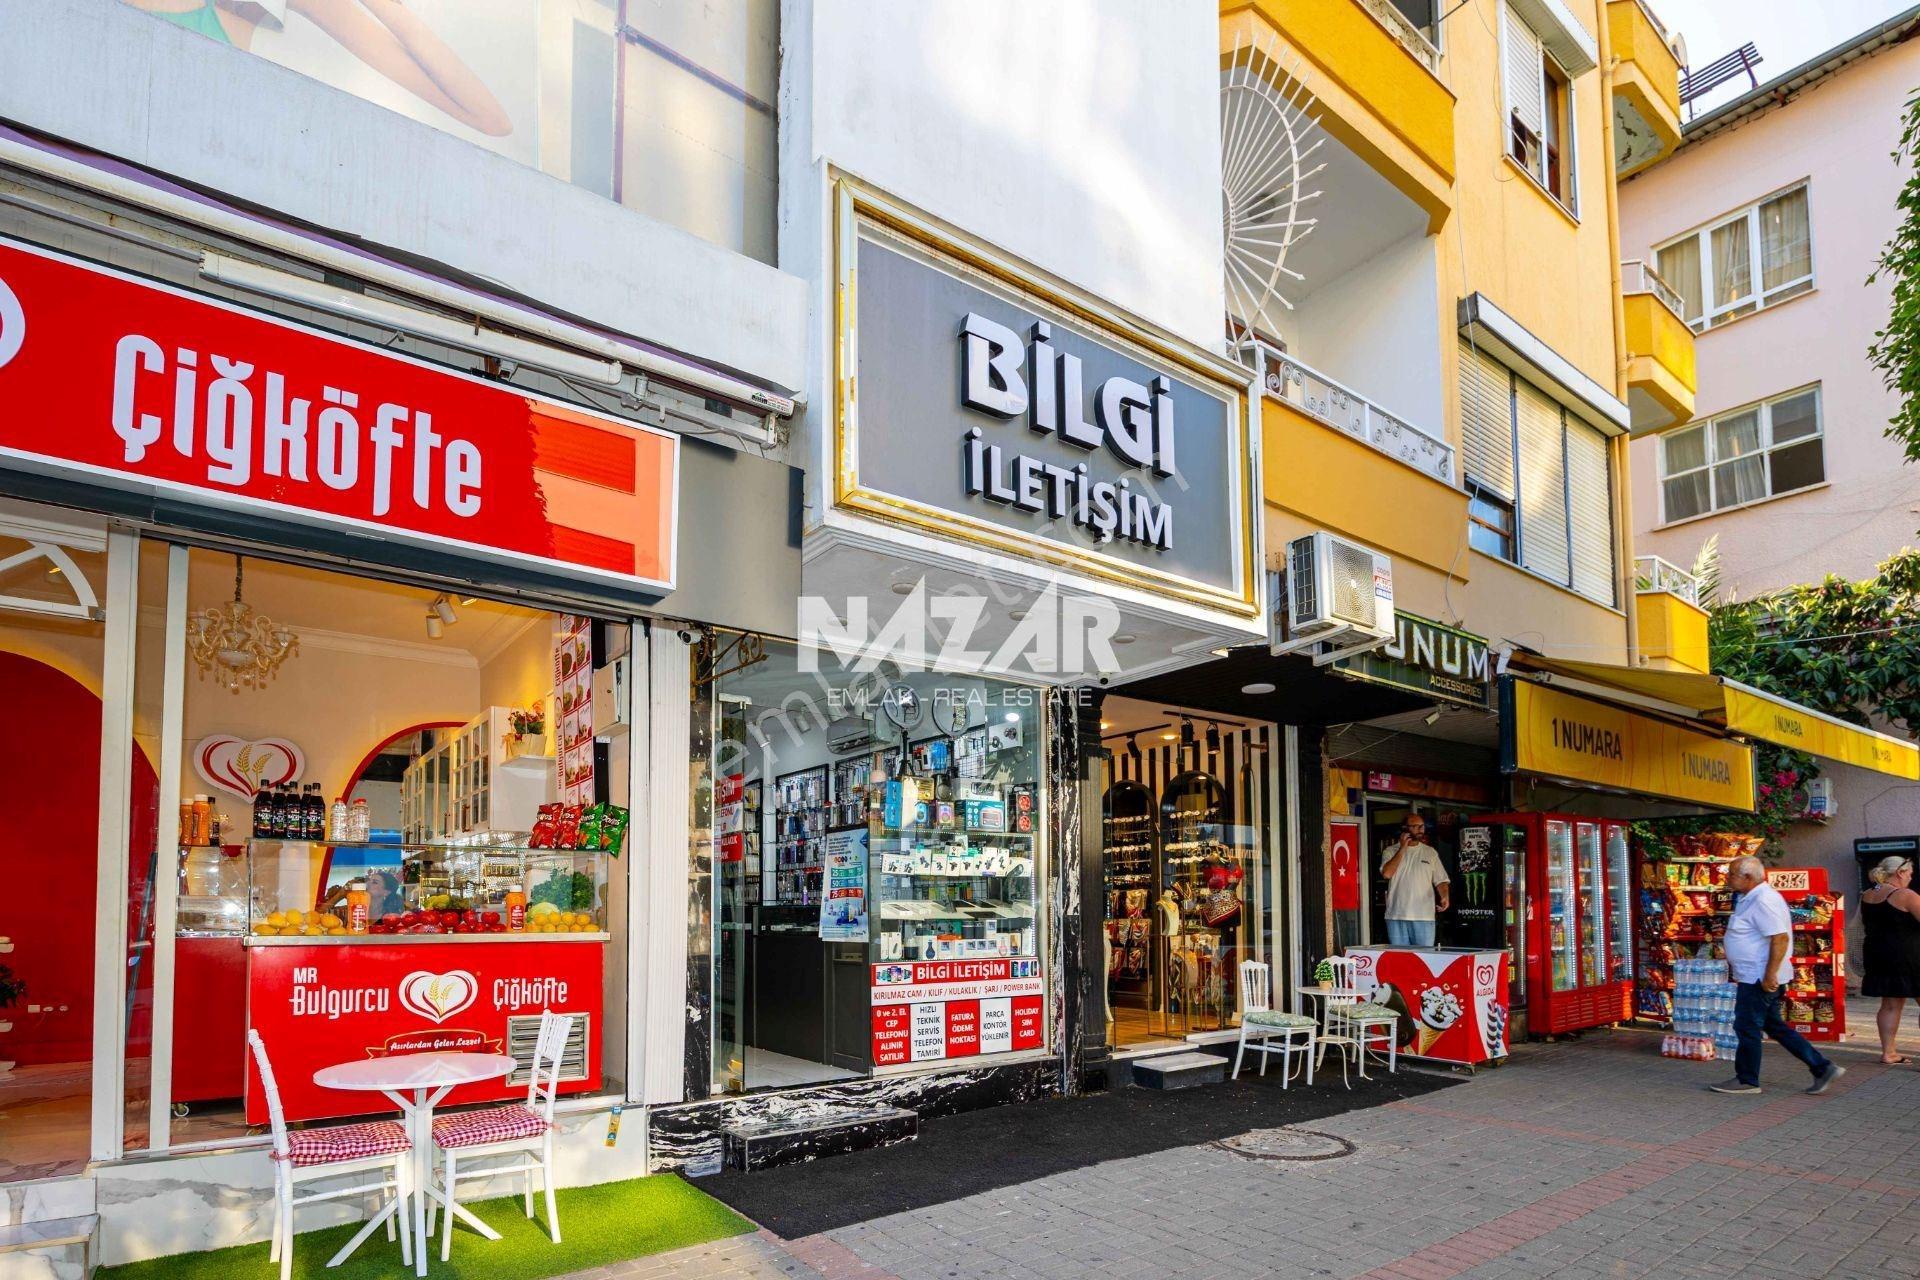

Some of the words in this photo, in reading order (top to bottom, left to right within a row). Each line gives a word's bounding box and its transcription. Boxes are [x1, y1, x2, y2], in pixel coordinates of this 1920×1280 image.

[958, 312, 1175, 479] BİLGİ
[112, 334, 482, 517] Çiğköfte
[964, 426, 1173, 552] İLETİŞİM
[1429, 674, 1482, 699] ACCESSORIES
[1552, 717, 1559, 748] 1
[1562, 719, 1623, 761] NUMARA
[1682, 752, 1686, 776] 1
[1688, 757, 1731, 786] NUMARA
[1457, 908, 1495, 917] MONSTER
[294, 967, 318, 984] MR
[917, 962, 950, 980] BİLGİ
[953, 960, 1005, 980] İLETİŞİM
[1349, 969, 1373, 978] AGIDA
[493, 976, 568, 1011] Çiğköfte
[874, 989, 906, 1000] KIRILMAZ
[907, 988, 922, 998] CAM
[928, 988, 943, 997] KILIF
[949, 986, 977, 996] KULAKLIK
[1003, 983, 1023, 993] POWER
[1024, 982, 1041, 992] BANK
[1476, 988, 1496, 997] ALGIDA
[289, 985, 389, 1020] Bulgurcu
[919, 1005, 937, 1014] HIZLI
[1014, 1007, 1039, 1017] HOLIDAY
[916, 1014, 941, 1025] TEKNİK
[951, 1013, 975, 1022] FATURA
[885, 1019, 898, 1028] CEP
[951, 1023, 974, 1033] ÖDEME
[875, 1029, 909, 1038] TELEFONU
[917, 1025, 940, 1036] SERVİS
[1019, 1029, 1035, 1038] CARD
[390, 1040, 432, 1052] Asırlardan
[434, 1038, 456, 1050] Gelen
[456, 1037, 481, 1047] Lezzet
[880, 1041, 903, 1051] ALINIR
[914, 1038, 943, 1048] TELEFON
[880, 1051, 905, 1062] SATILIR
